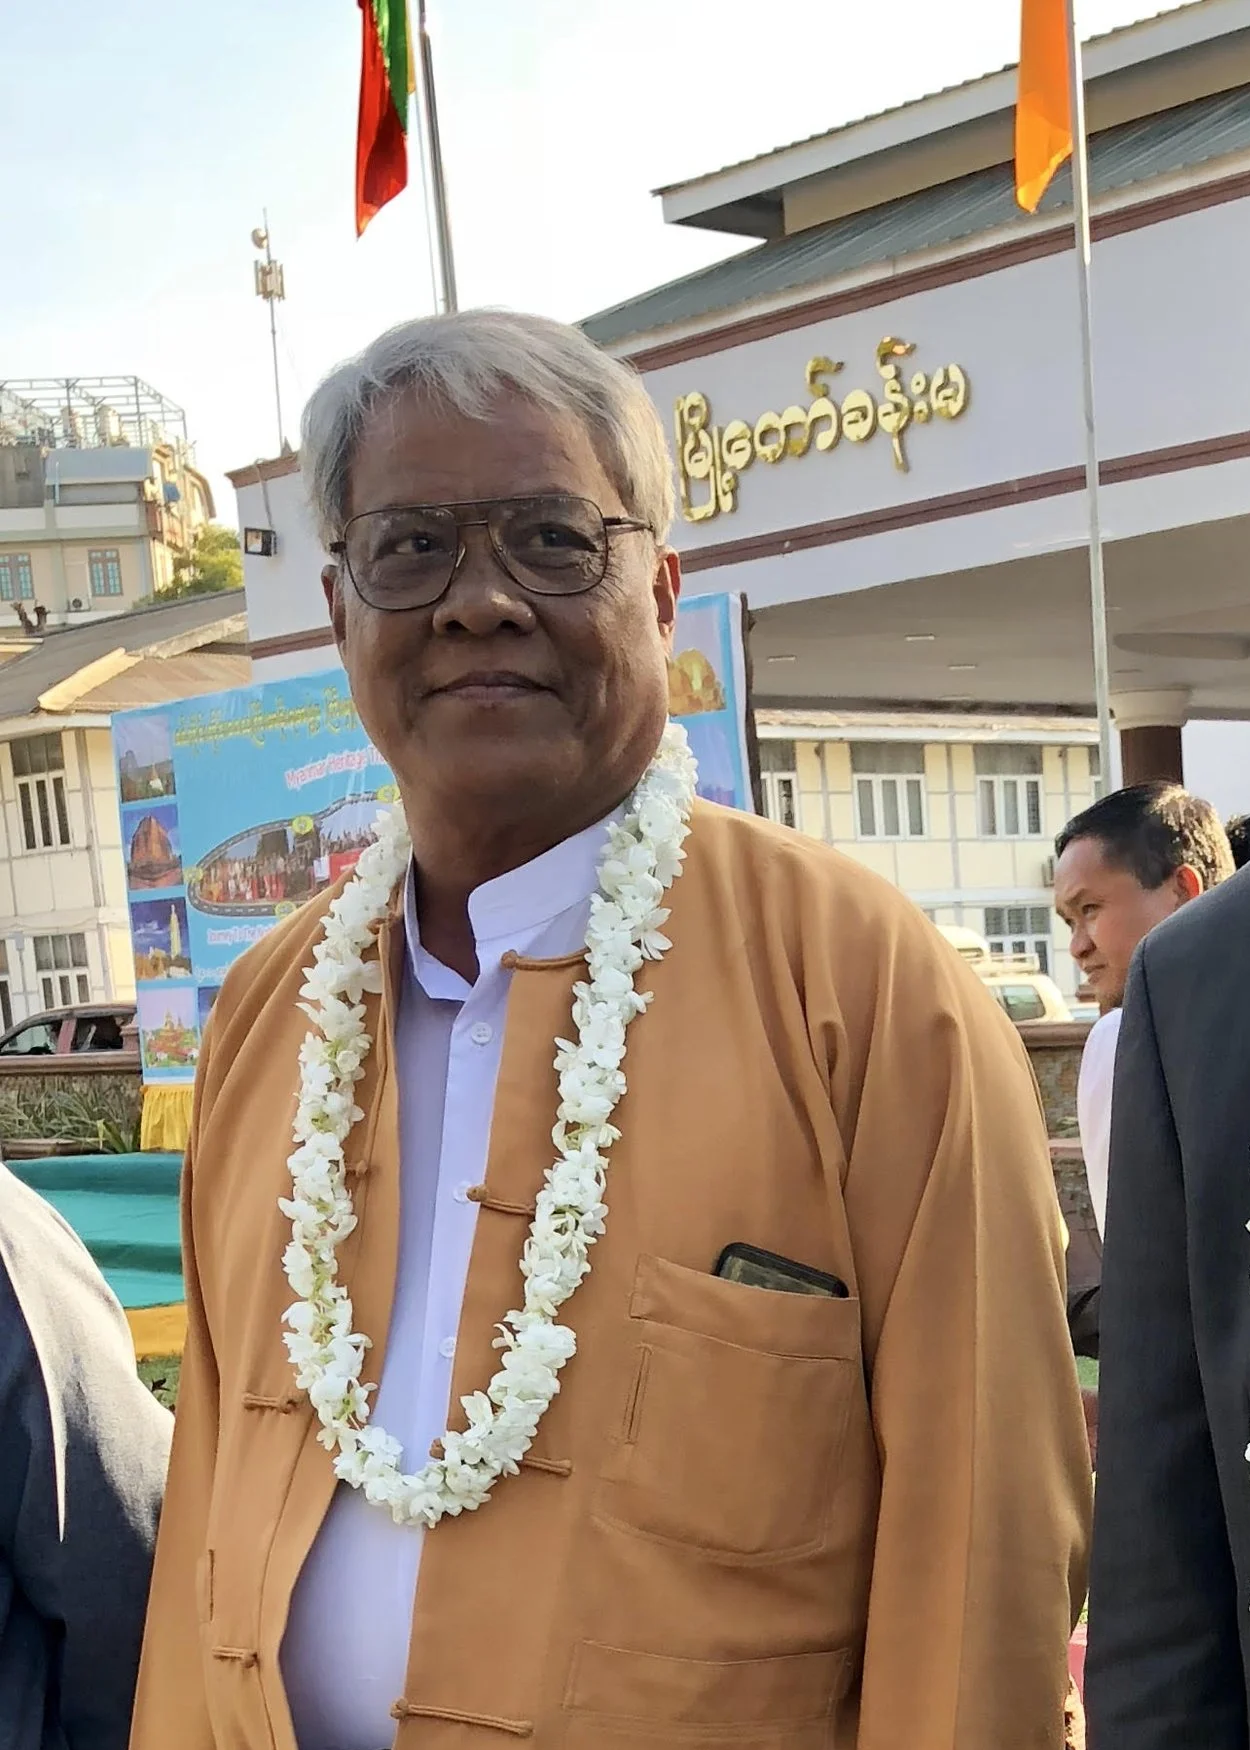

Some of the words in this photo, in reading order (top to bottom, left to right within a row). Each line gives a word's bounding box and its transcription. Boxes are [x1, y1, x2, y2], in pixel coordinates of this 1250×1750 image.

[675, 337, 966, 522] မြို့တော်ခန်းမ
